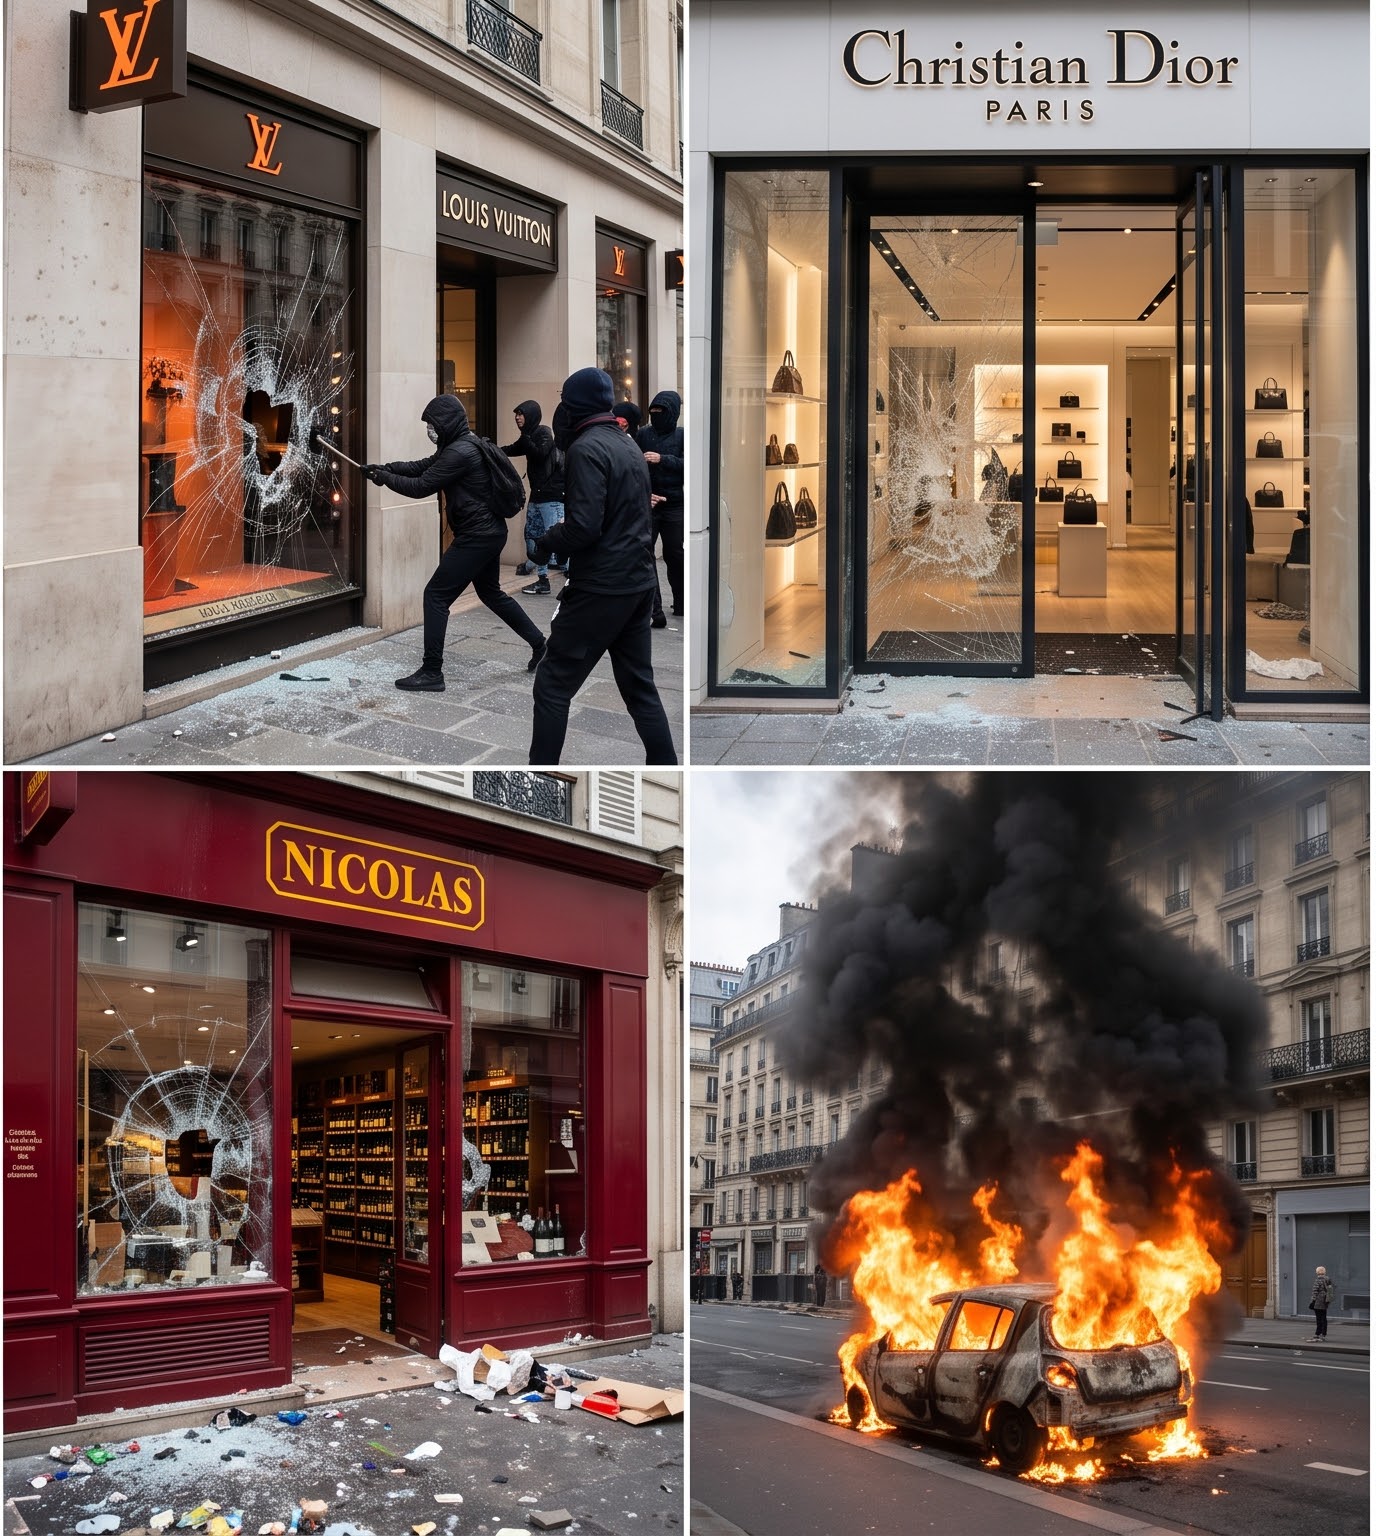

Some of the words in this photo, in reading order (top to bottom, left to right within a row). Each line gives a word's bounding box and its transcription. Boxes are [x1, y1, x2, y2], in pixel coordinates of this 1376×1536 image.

[842, 28, 1090, 86] Christian
[1106, 28, 1240, 85] Dior
[985, 99, 1096, 121] PARIS
[442, 190, 489, 229] LOUIS
[493, 206, 551, 248] VUITTON
[281, 839, 473, 915] NICOLAS
